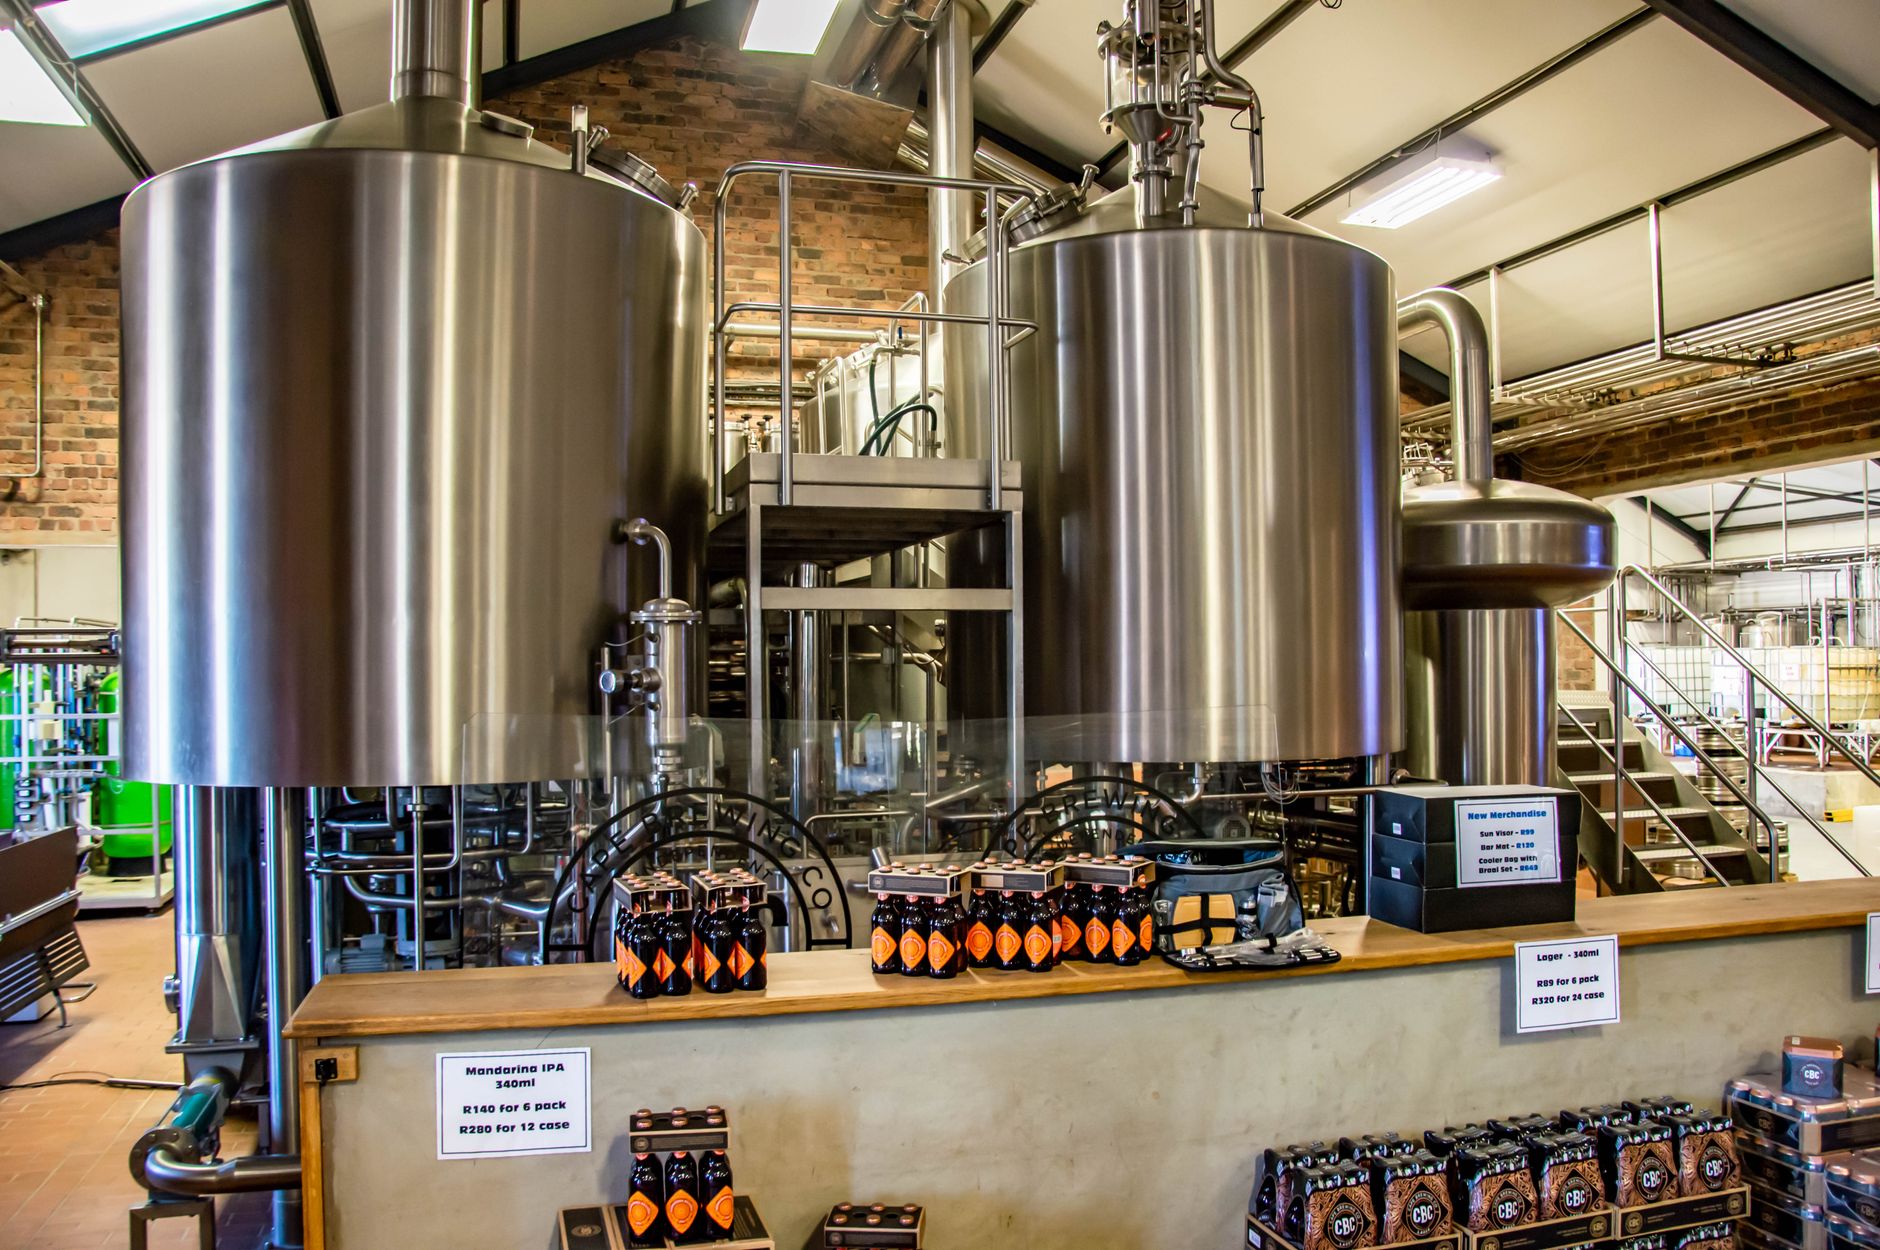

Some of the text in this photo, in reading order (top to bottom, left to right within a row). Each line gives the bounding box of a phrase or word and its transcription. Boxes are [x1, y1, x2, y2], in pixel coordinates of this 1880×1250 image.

[1468, 810, 1547, 820] New Merchandise
[1479, 857, 1502, 865] Cooler
[1504, 856, 1518, 864] Bag
[567, 830, 632, 913] CAPE
[802, 866, 833, 909] CO
[1537, 953, 1563, 962] Lager
[1574, 949, 1599, 959] 340ml
[1537, 979, 1554, 988] R89
[1556, 978, 1570, 986] for
[1579, 974, 1599, 985] pack
[1532, 991, 1605, 1005] R320 for 24 case
[465, 1063, 565, 1076] Mandarina IPA
[1804, 1070, 1820, 1080] CBC
[495, 1078, 535, 1089] 340ml
[463, 1099, 567, 1115] R140 for 6 pack
[459, 1121, 570, 1135] R280 for 12 case
[1706, 1159, 1723, 1176] CBC
[1643, 1170, 1661, 1188] CBC
[1566, 1189, 1585, 1207] CBC
[1412, 1204, 1433, 1224] CBC
[1498, 1201, 1518, 1219] CBC
[1334, 1216, 1356, 1236] CBC
